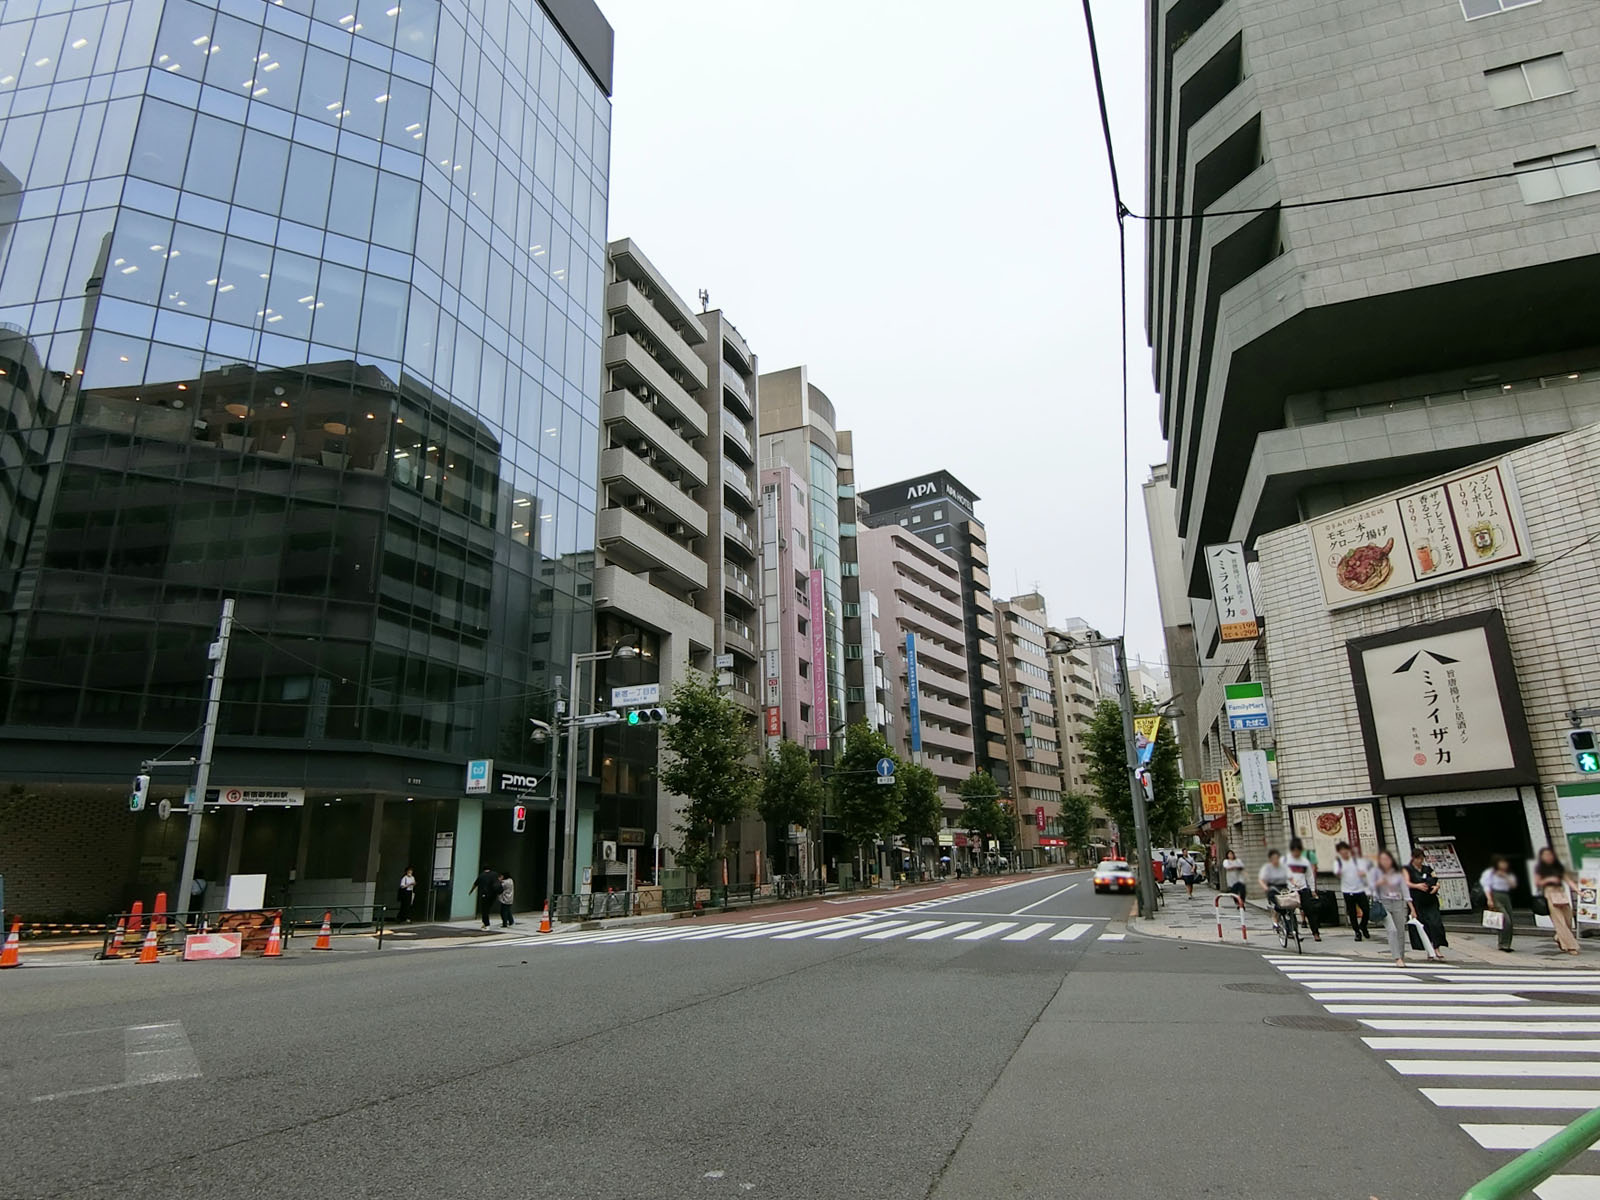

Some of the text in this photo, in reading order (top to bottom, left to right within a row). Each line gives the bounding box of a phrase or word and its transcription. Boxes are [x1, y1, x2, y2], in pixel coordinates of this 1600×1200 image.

[907, 482, 937, 500] APA
[946, 484, 973, 512] APA HOTEL
[1459, 483, 1469, 507] 199
[1468, 481, 1485, 518] ハイボール
[1480, 474, 1498, 517] ジムビーム
[1407, 500, 1417, 522] 299
[1420, 494, 1436, 534] 香るエール
[1326, 522, 1366, 541] モモ一本
[1219, 560, 1236, 618] ミライザカ
[1228, 702, 1264, 711] FamilyMart
[1423, 670, 1451, 765] ミライザカ
[1233, 718, 1265, 729] 酒 たばこ
[501, 774, 537, 790] pmo
[1202, 783, 1221, 796] 100
[1204, 803, 1224, 813] ショップ
